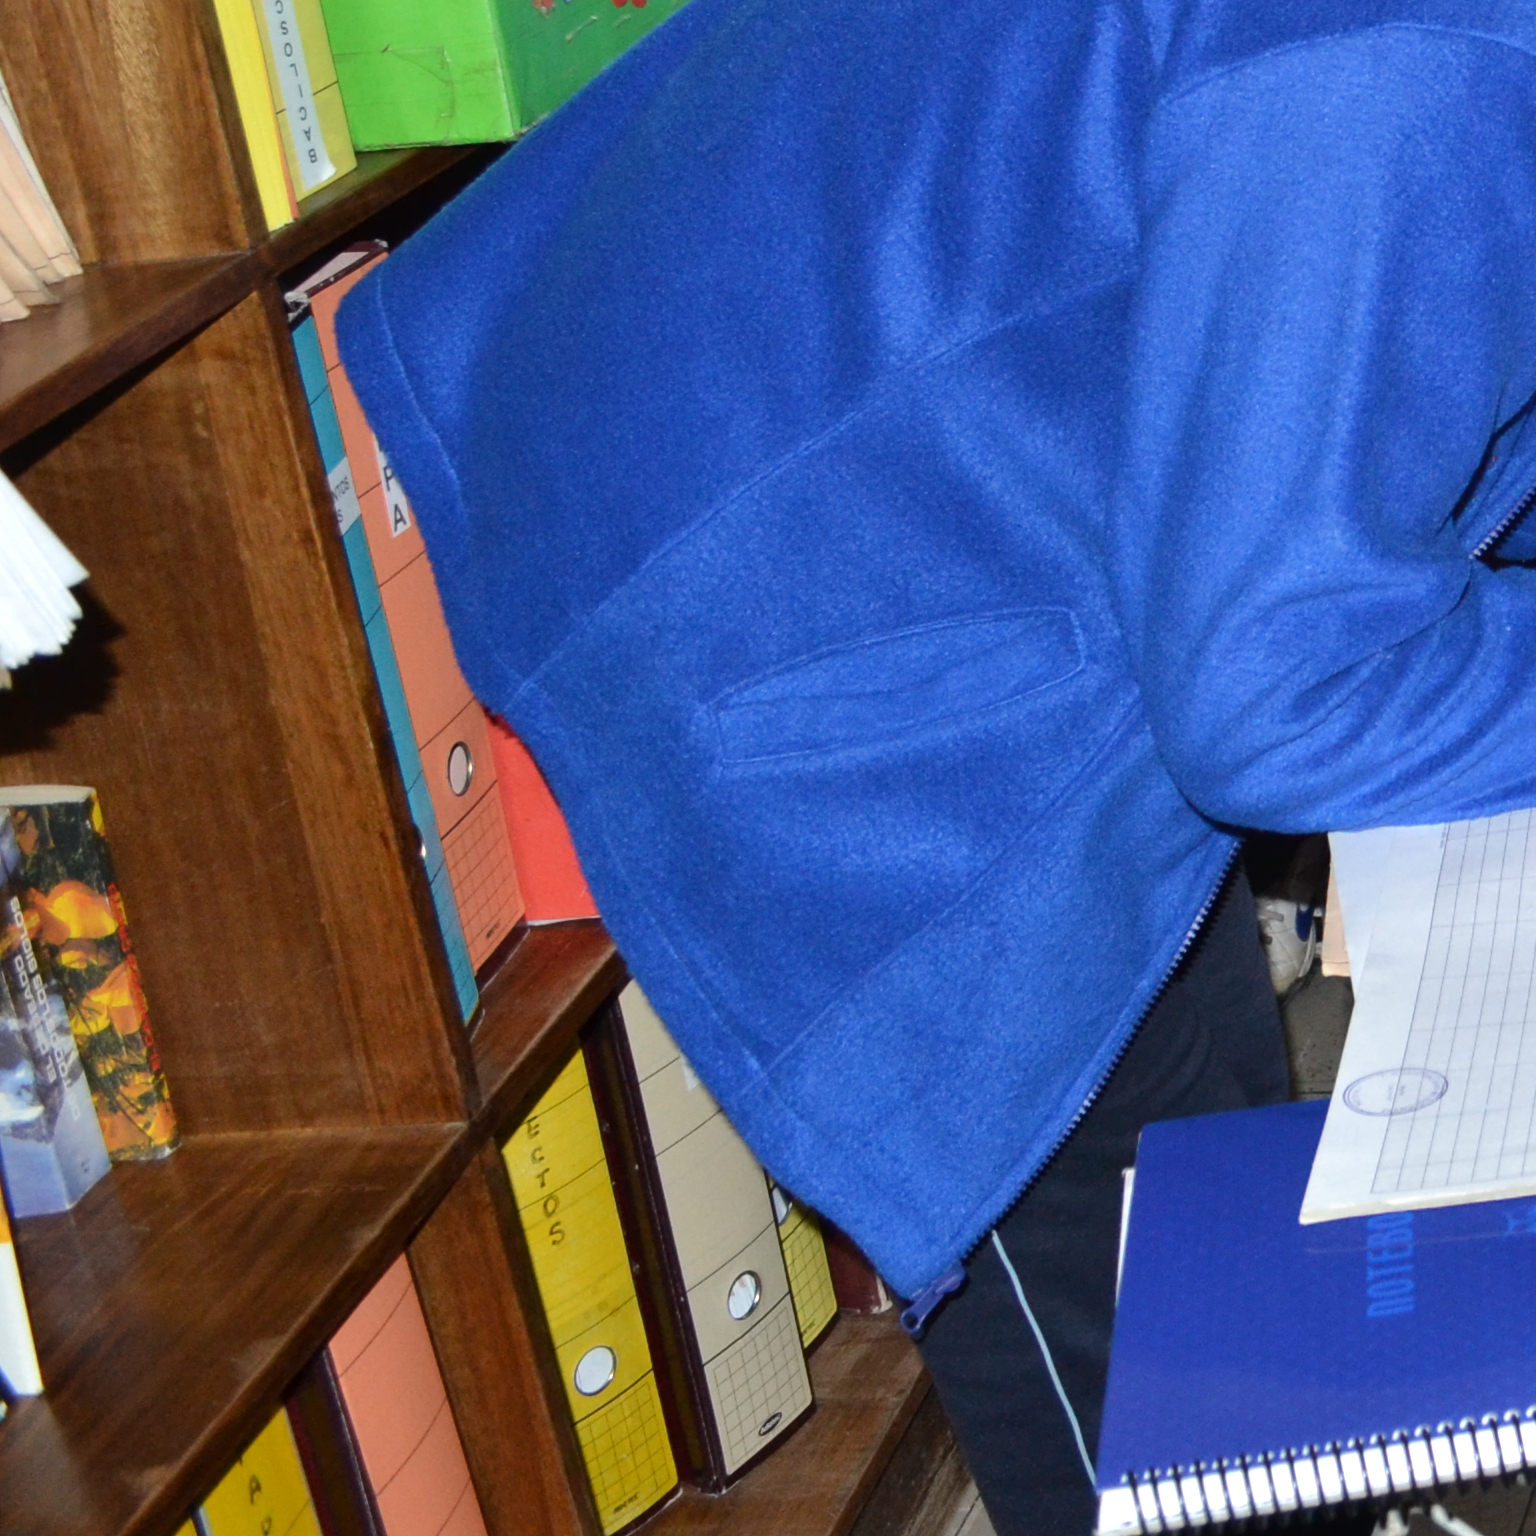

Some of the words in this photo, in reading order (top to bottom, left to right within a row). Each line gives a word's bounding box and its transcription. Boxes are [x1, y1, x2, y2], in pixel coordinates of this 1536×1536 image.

[9, 894, 38, 974] SIGLOS
[13, 953, 50, 1055] DESEADO
[34, 972, 53, 1018] LOS
[45, 1055, 58, 1084] EL
